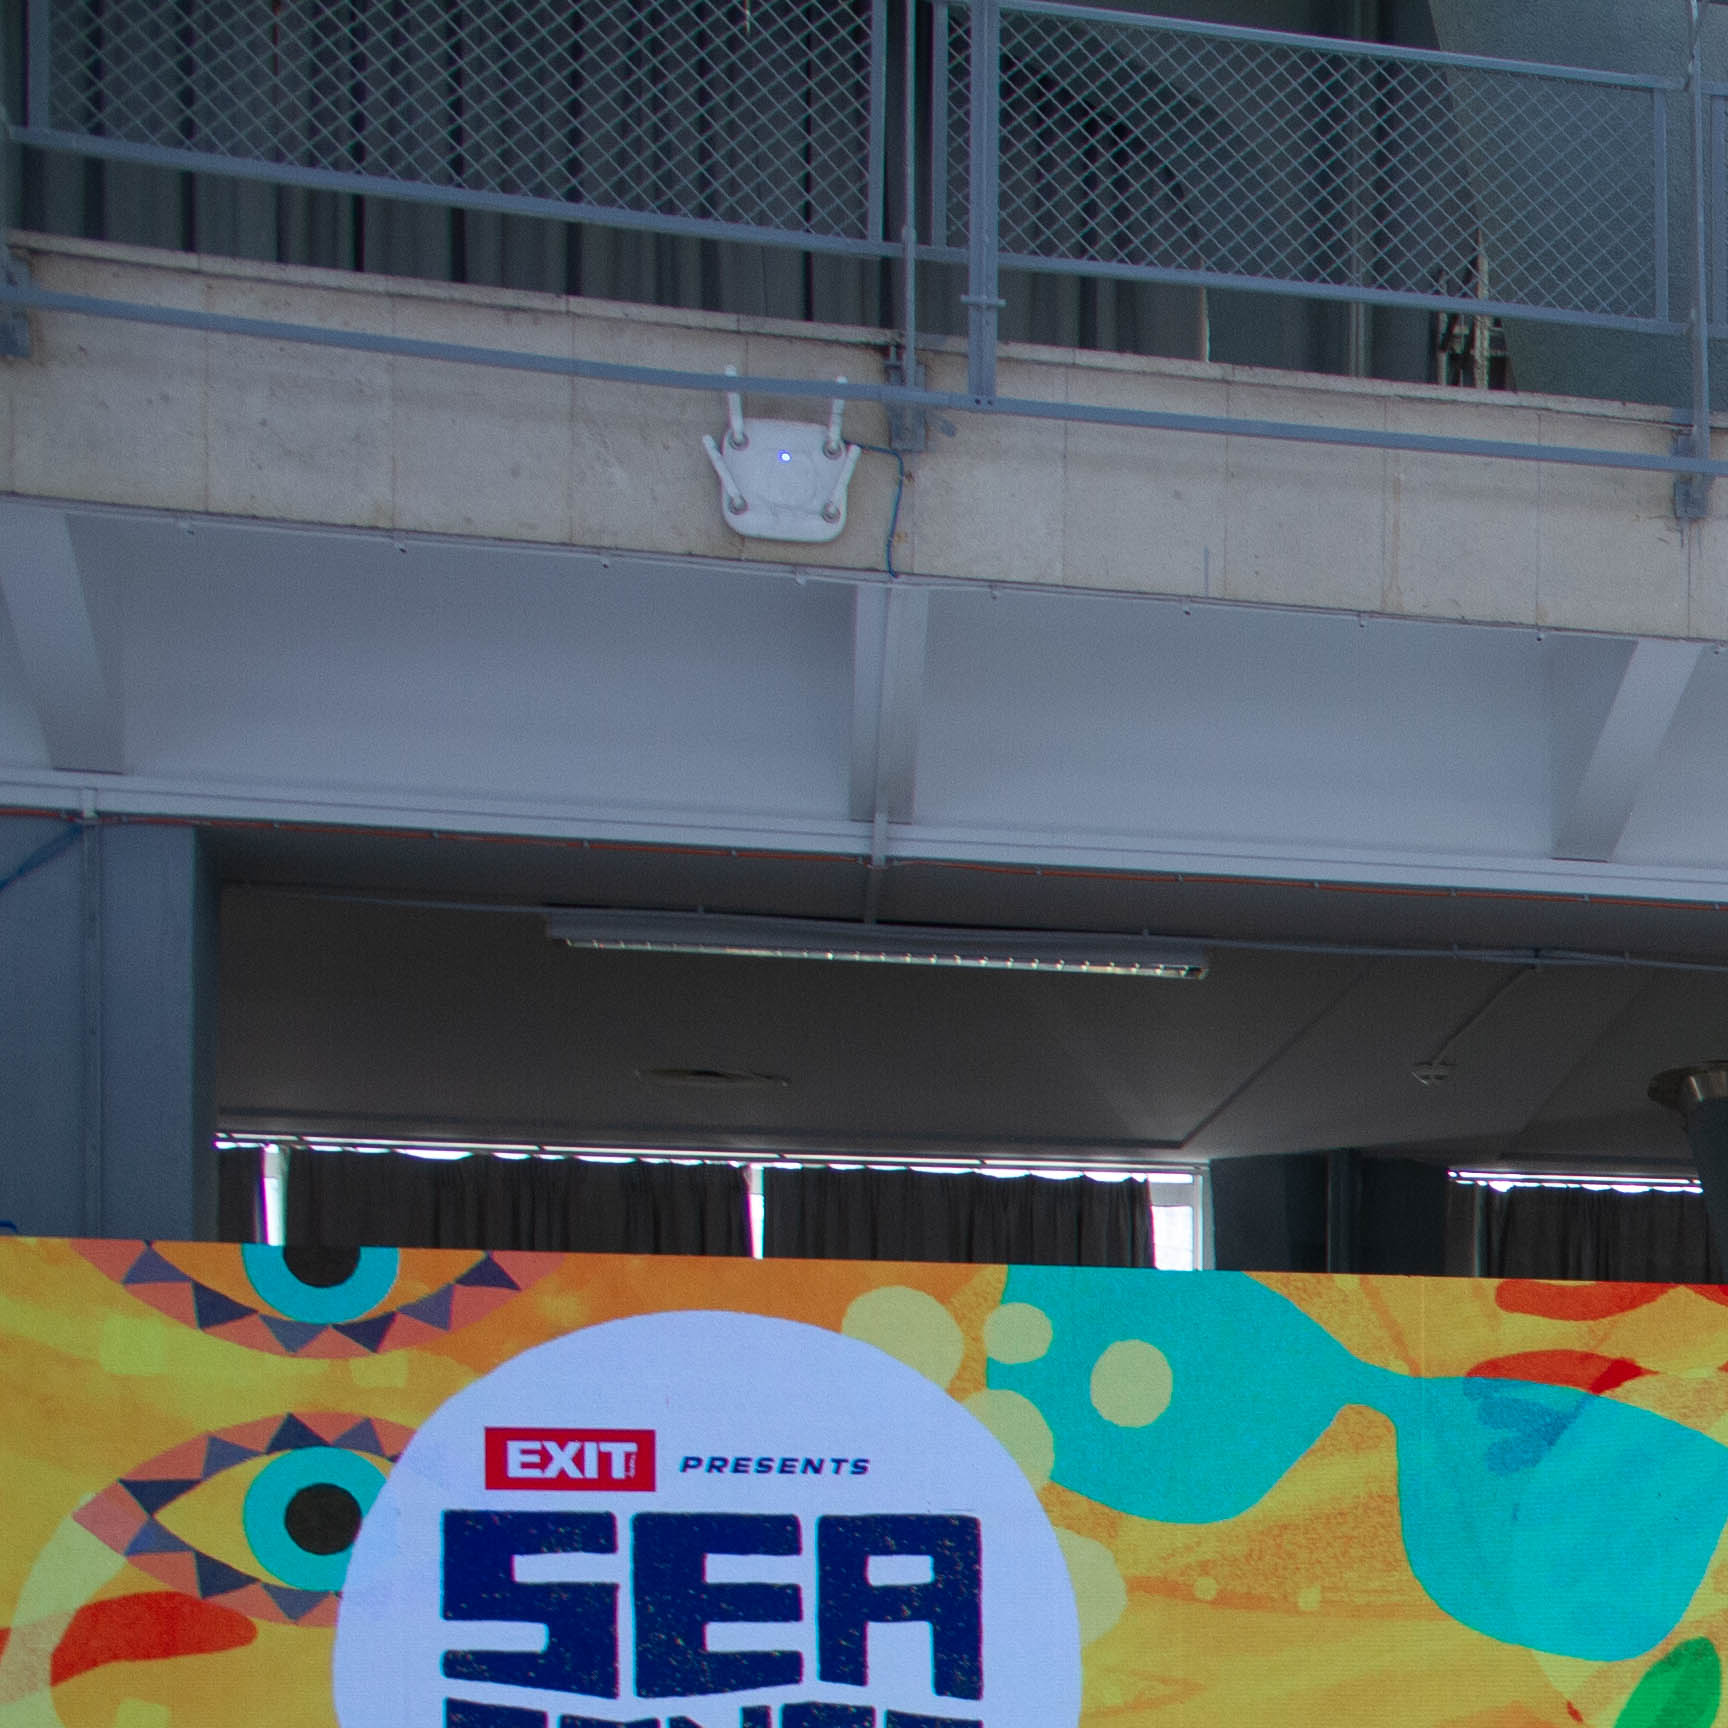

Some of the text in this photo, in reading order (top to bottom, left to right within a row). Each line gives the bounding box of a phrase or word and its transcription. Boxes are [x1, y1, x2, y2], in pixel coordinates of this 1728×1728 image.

[506, 1440, 870, 1480] EXIT PRESENTS
[441, 1508, 983, 1700] SEA
